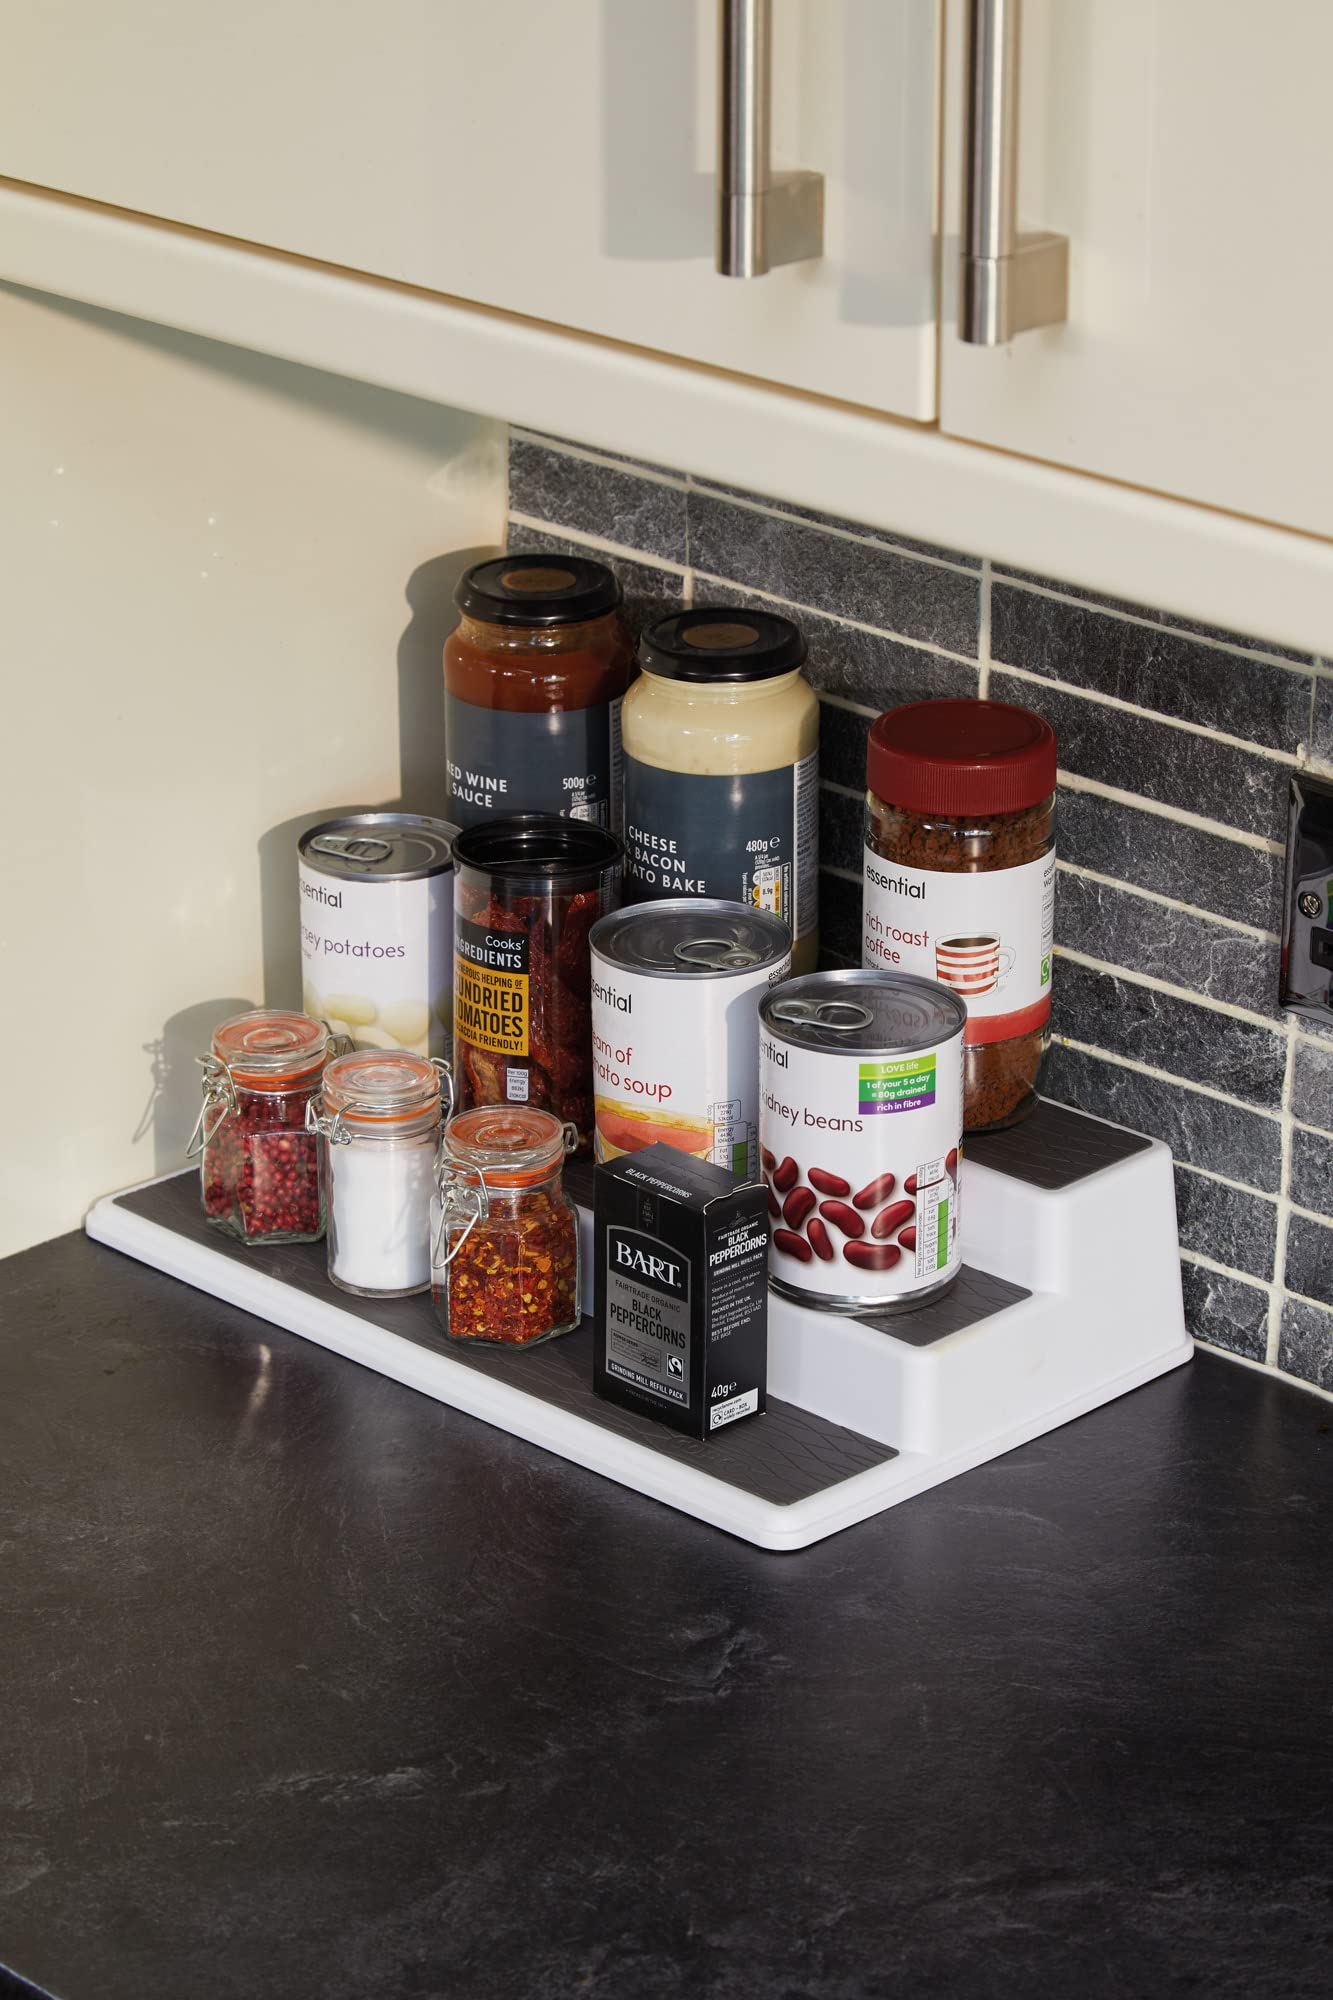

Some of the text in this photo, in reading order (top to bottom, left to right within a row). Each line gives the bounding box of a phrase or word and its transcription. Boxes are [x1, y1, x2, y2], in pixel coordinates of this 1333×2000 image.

[466, 771, 508, 792] WINE
[562, 777, 584, 790] 500g
[452, 782, 493, 808] SAUCE
[628, 825, 677, 854] CHEESE
[746, 840, 768, 852] 480g
[635, 846, 686, 874] BACON
[662, 874, 706, 894] BAKE
[866, 865, 925, 900] essential
[866, 910, 930, 948] rich roast
[324, 939, 405, 958] potatoes
[486, 936, 525, 950] Cooks'
[866, 936, 900, 964] coffee
[481, 974, 512, 988] HELPING
[480, 1032, 523, 1050] FRIENDLY!
[616, 1048, 632, 1066] of
[881, 1061, 918, 1074] LOVE life
[624, 1078, 672, 1102] soup
[872, 1080, 882, 1088] of
[882, 1080, 902, 1090] your
[904, 1078, 908, 1086] 5
[916, 1074, 931, 1082] day
[878, 1091, 896, 1100] 80g
[896, 1084, 927, 1096] drained
[876, 1100, 922, 1112] rich in fibre
[804, 1108, 864, 1132] beans
[625, 1168, 692, 1198] BLACK PEPPERCORNS
[728, 1230, 749, 1246] BLACK
[710, 1233, 767, 1267] PEPPERCORNS
[616, 1240, 680, 1287] BART
[616, 1280, 681, 1312] FAIRTRADE ORGANIC
[632, 1298, 662, 1322] BLACK
[712, 1304, 730, 1316] PACKED
[610, 1302, 686, 1350] PEPPERCORNS
[724, 1320, 740, 1332] BEFORE
[613, 1363, 635, 1380] GRINDING
[636, 1374, 648, 1386] MILL
[650, 1380, 668, 1394] REFILL
[668, 1388, 684, 1400] PACK
[711, 1384, 728, 1398] 40g
